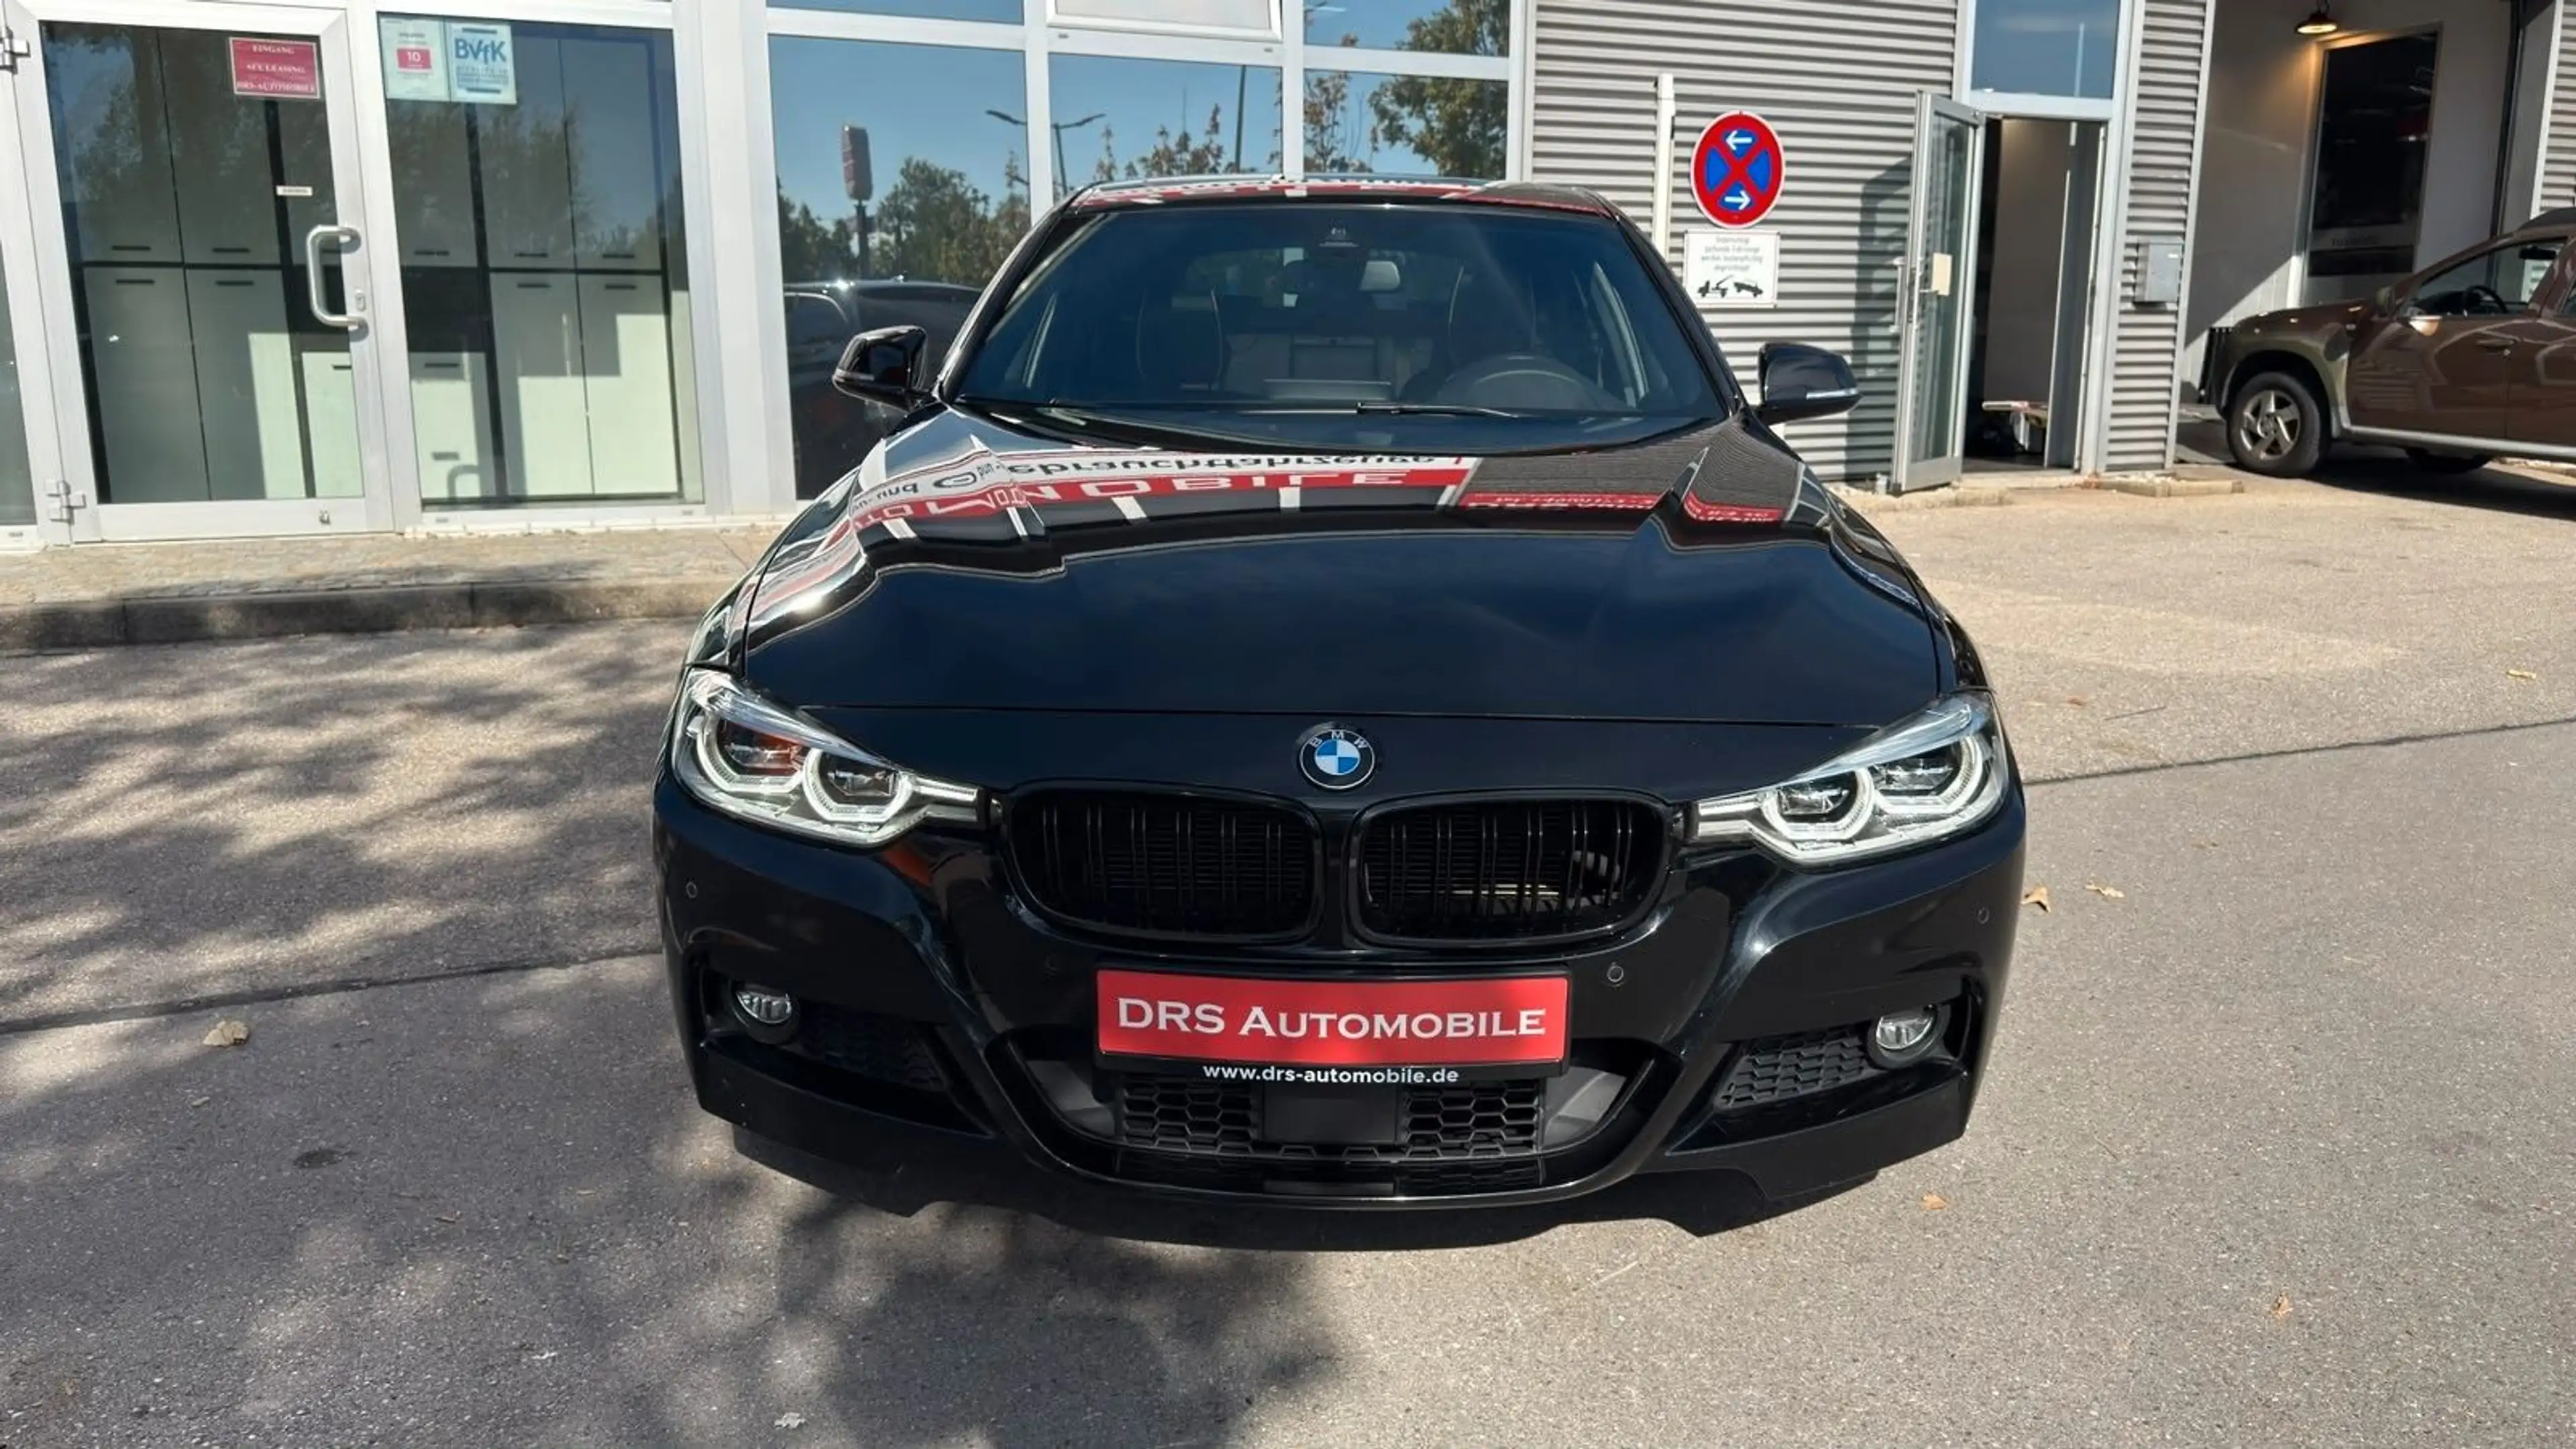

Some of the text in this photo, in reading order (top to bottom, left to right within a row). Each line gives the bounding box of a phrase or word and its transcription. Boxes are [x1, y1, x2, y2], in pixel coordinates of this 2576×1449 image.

[407, 51, 421, 62] 10
[454, 38, 507, 65] BVfK
[1308, 729, 1369, 749] BMW
[1118, 998, 1546, 1039] DRS AUTOMOBILE
[1203, 1065, 1459, 1083] www.drs-automobile.de
